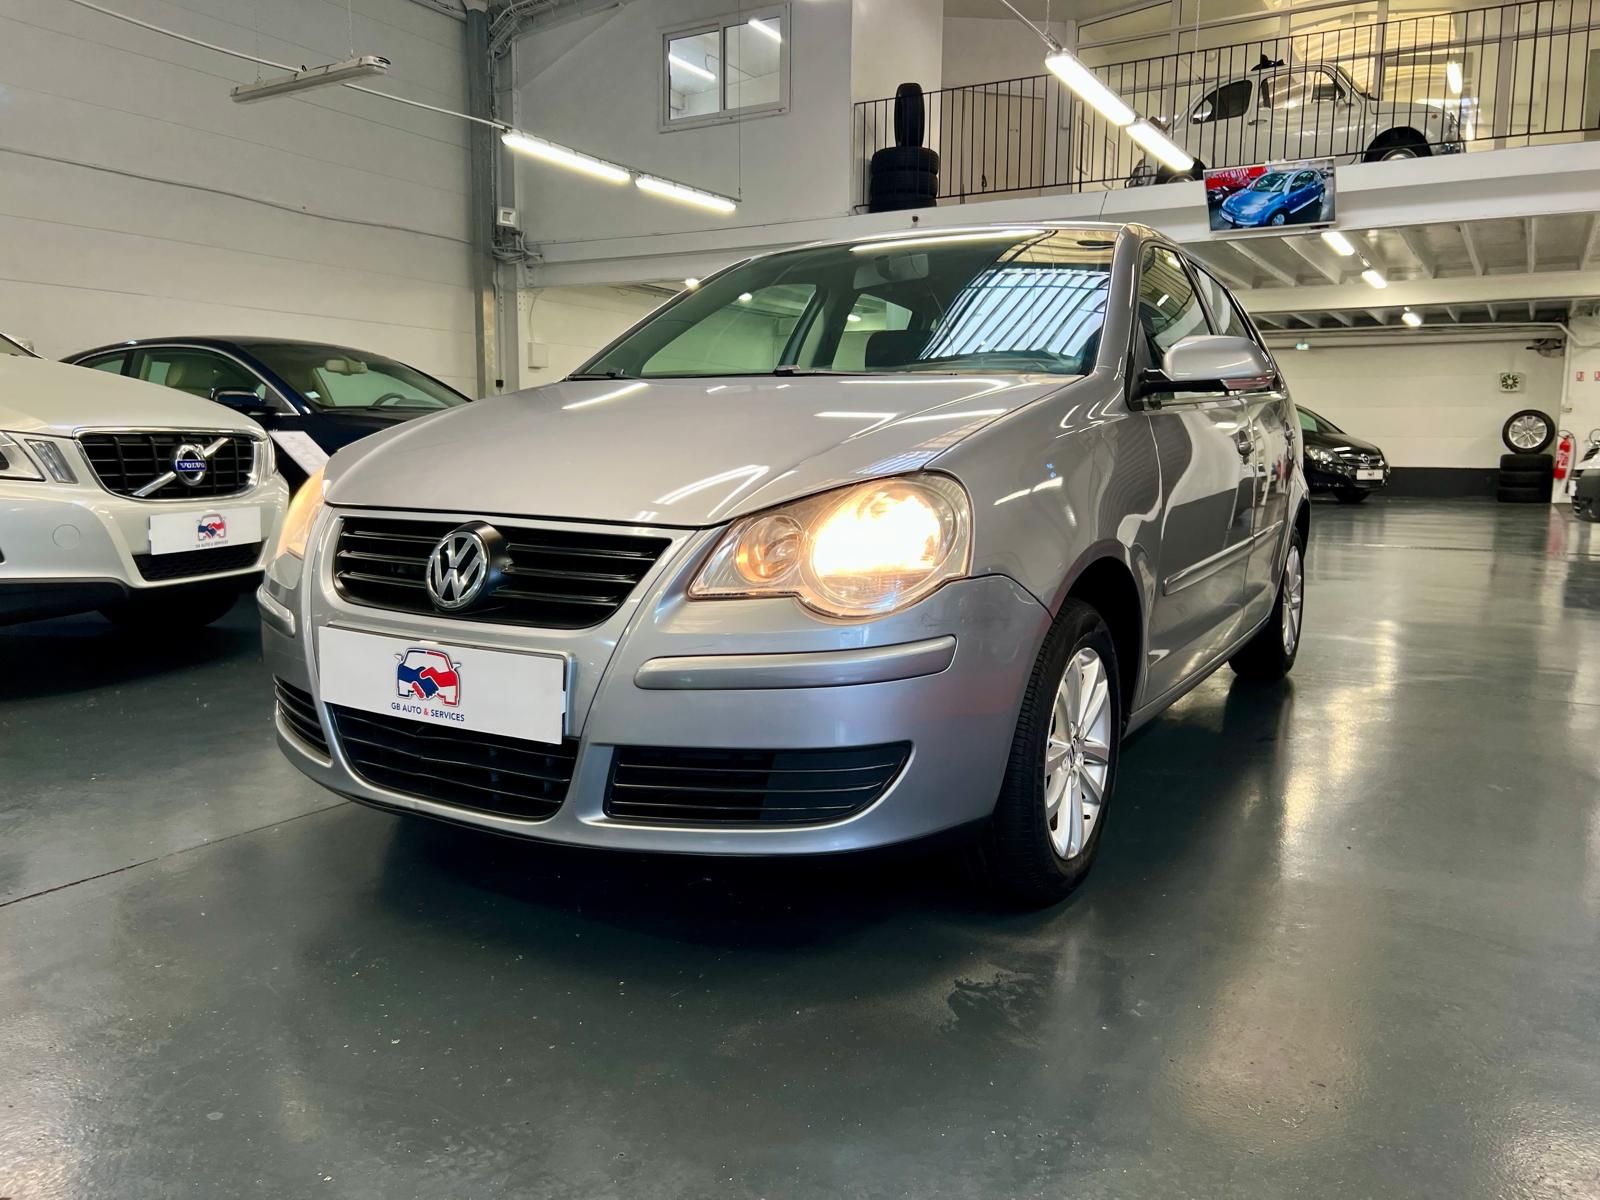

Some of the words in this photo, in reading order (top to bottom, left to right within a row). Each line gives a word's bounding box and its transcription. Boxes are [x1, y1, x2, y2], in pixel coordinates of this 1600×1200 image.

[391, 702, 401, 711] GB
[402, 704, 422, 715] AUTO
[423, 707, 429, 716] &
[430, 709, 465, 722] SERVICES
